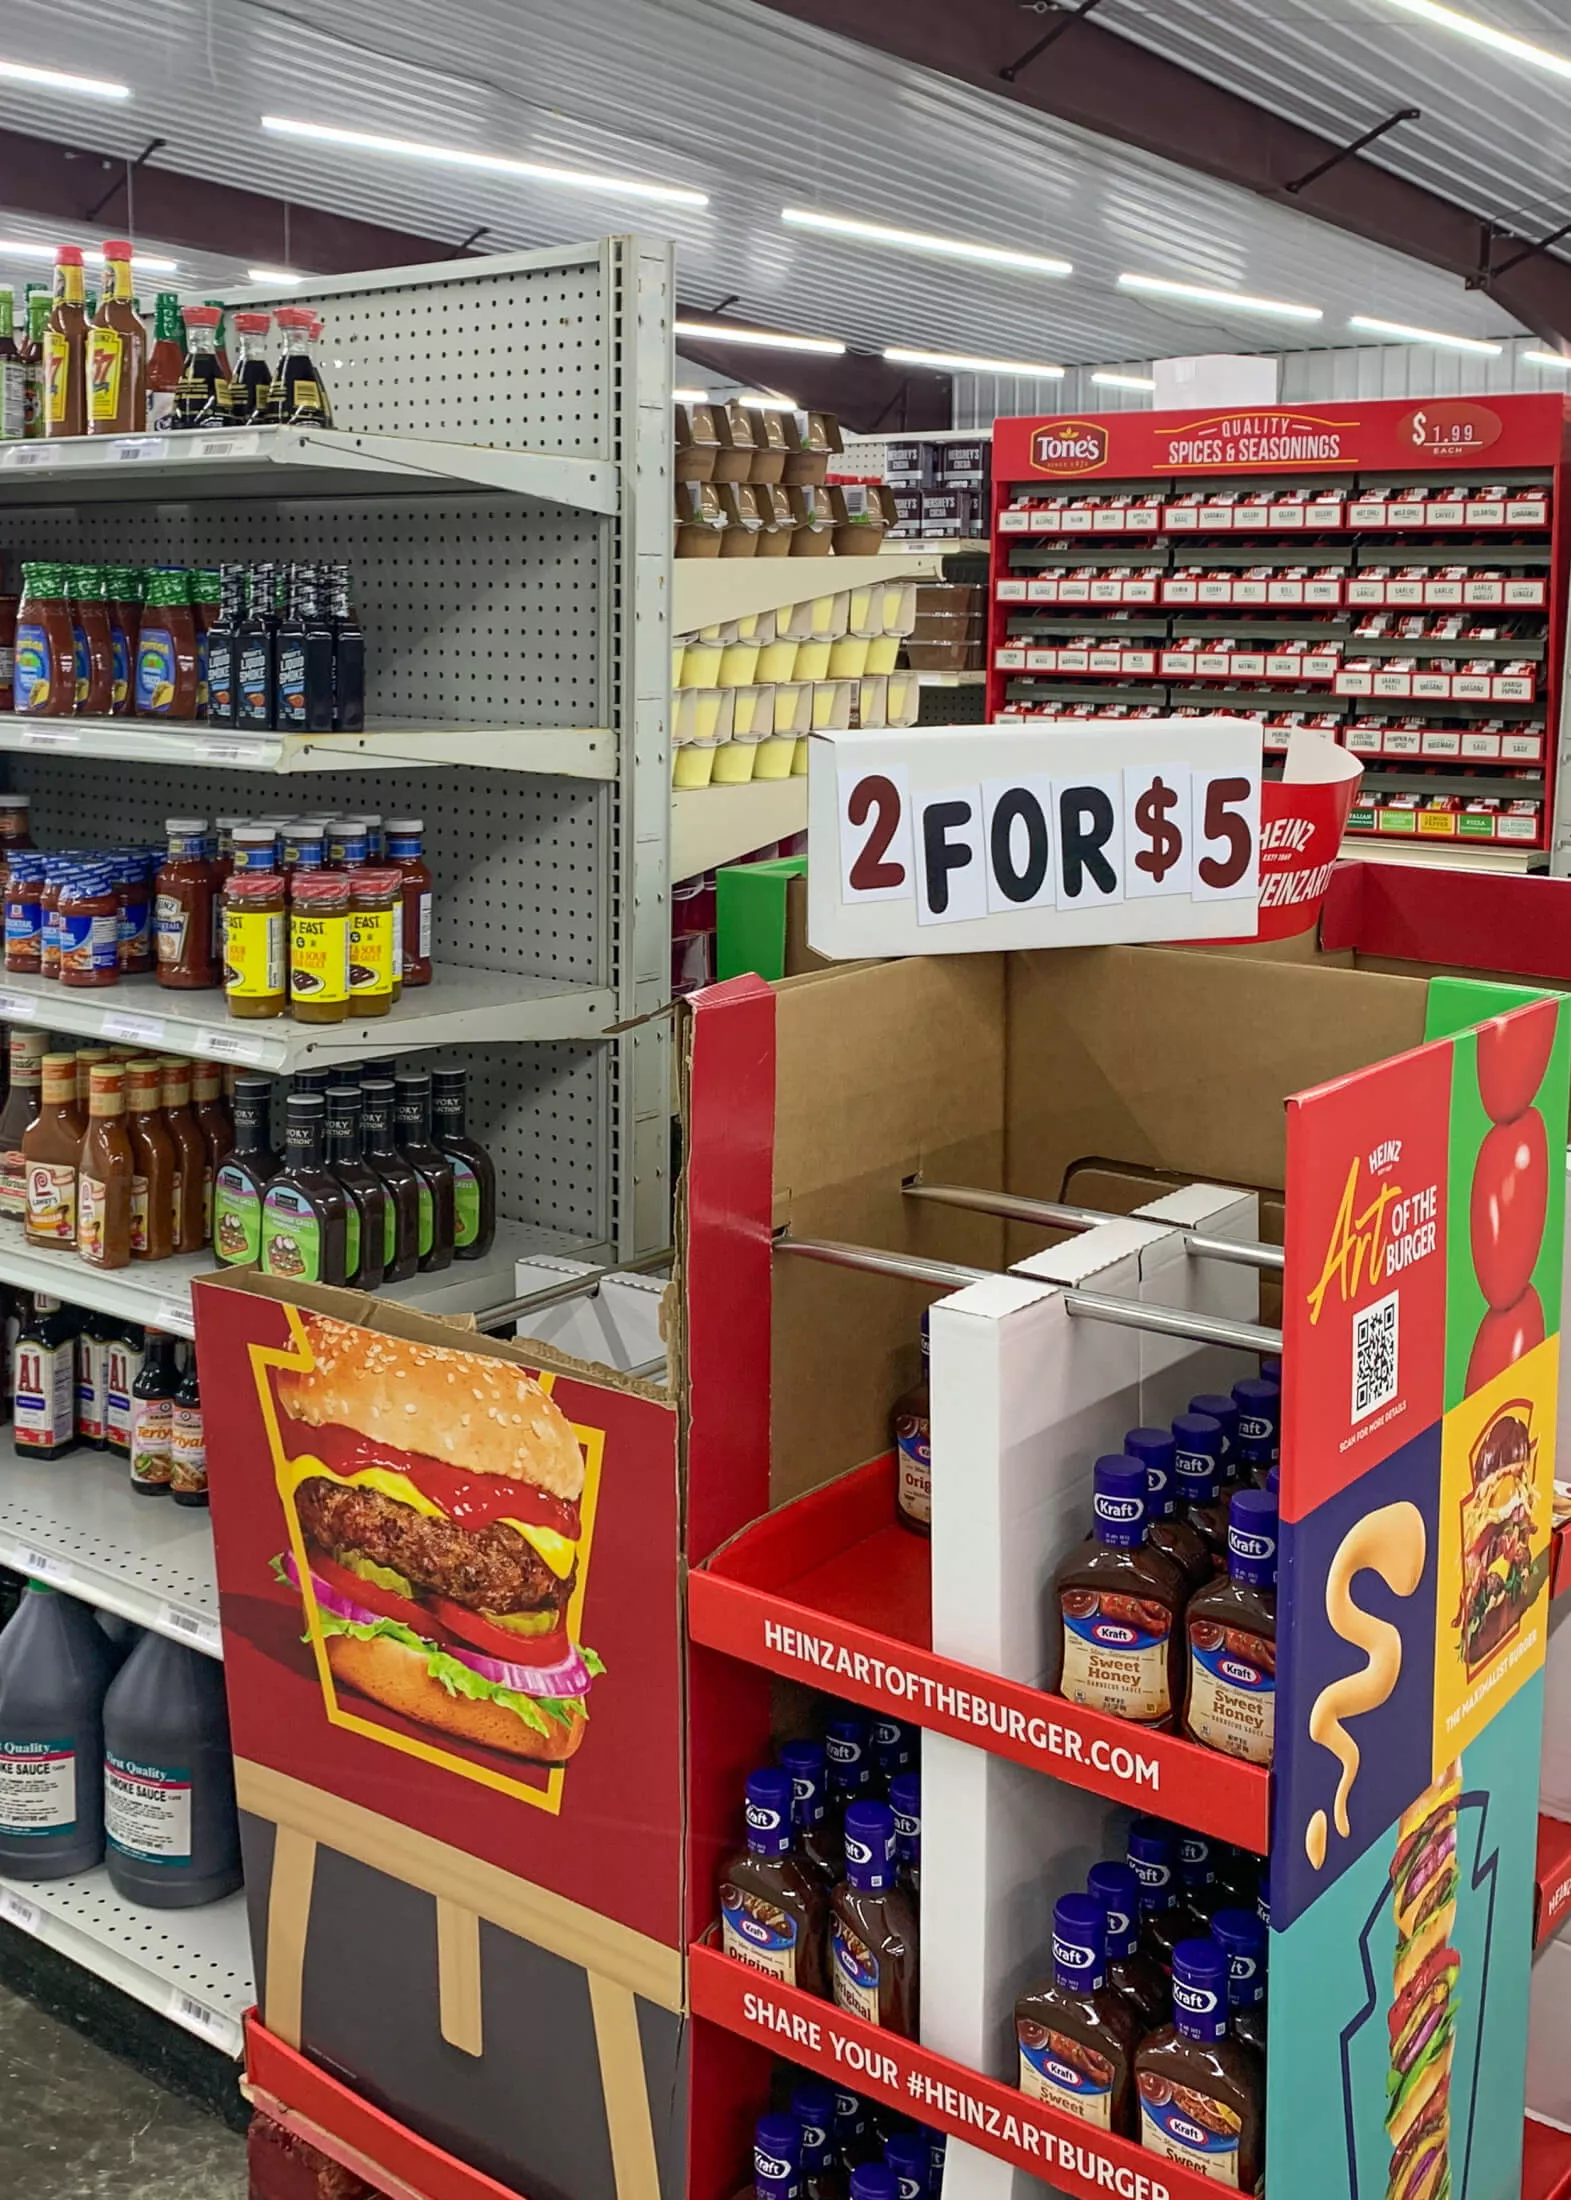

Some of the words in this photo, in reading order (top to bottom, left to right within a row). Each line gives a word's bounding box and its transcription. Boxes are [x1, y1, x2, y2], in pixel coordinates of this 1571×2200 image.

[1222, 417, 1289, 438] QUALITY
[1037, 435, 1099, 462] Tone's
[1168, 440, 1222, 465] SPICES
[1226, 442, 1236, 461] &
[1239, 434, 1340, 462] SEASONINGS
[1433, 447, 1463, 455] EACH
[848, 775, 906, 890] 2
[923, 785, 1117, 914] FOR
[1134, 775, 1252, 889] $5
[300, 921, 325, 934] EAST
[354, 916, 380, 929] EAST
[1368, 1139, 1402, 1175] HEINZ
[1391, 1198, 1411, 1237] OF
[1411, 1184, 1438, 1226] THE
[1307, 1156, 1403, 1326] Art
[1386, 1221, 1437, 1277] BURGER
[136, 1425, 173, 1440] Teriy
[1240, 1421, 1261, 1435] raft
[1339, 1433, 1356, 1453] SCAN
[1356, 1426, 1369, 1441] FOR
[1368, 1415, 1385, 1433] MORE
[905, 1472, 931, 1493] Orig
[1099, 1499, 1134, 1517] Kraft
[1230, 1533, 1262, 1555] Kraft
[1101, 1628, 1127, 1640] Kraft
[1089, 1655, 1140, 1673] Sweet
[1227, 1663, 1251, 1680] Kraft
[1086, 1679, 1119, 1691] BARBECUE
[1121, 1683, 1141, 1694] SAUCE
[1088, 1667, 1141, 1687] Honey
[1445, 1705, 1461, 1733] THE
[1508, 1628, 1537, 1668] BURGER
[764, 1619, 1160, 1791] HEINZARTOFTHEBURGER.COM
[1215, 1689, 1263, 1716] Sweet
[1213, 1701, 1264, 1729] Honey
[4, 1742, 52, 1755] Quality
[16, 1763, 51, 1775] SAUCE
[125, 1760, 168, 1780] Quality
[136, 1785, 167, 1802] SAUCE
[894, 1816, 911, 1831] aft
[845, 1843, 861, 1859] aft
[1256, 1903, 1270, 1924] Kra
[745, 1923, 764, 1939] Kraft
[842, 1952, 857, 1970] Kraft
[1053, 1940, 1082, 1964] Kraft
[729, 1946, 785, 1983] Original
[1172, 1984, 1203, 2009] Kraft
[743, 1992, 822, 2052] SHARE
[828, 2030, 900, 2090] YOUR
[1050, 2064, 1074, 2081] Kraft
[1040, 2086, 1085, 2117] Sweet
[1173, 2122, 1199, 2140] Kraft
[1165, 2147, 1208, 2177] Sweet
